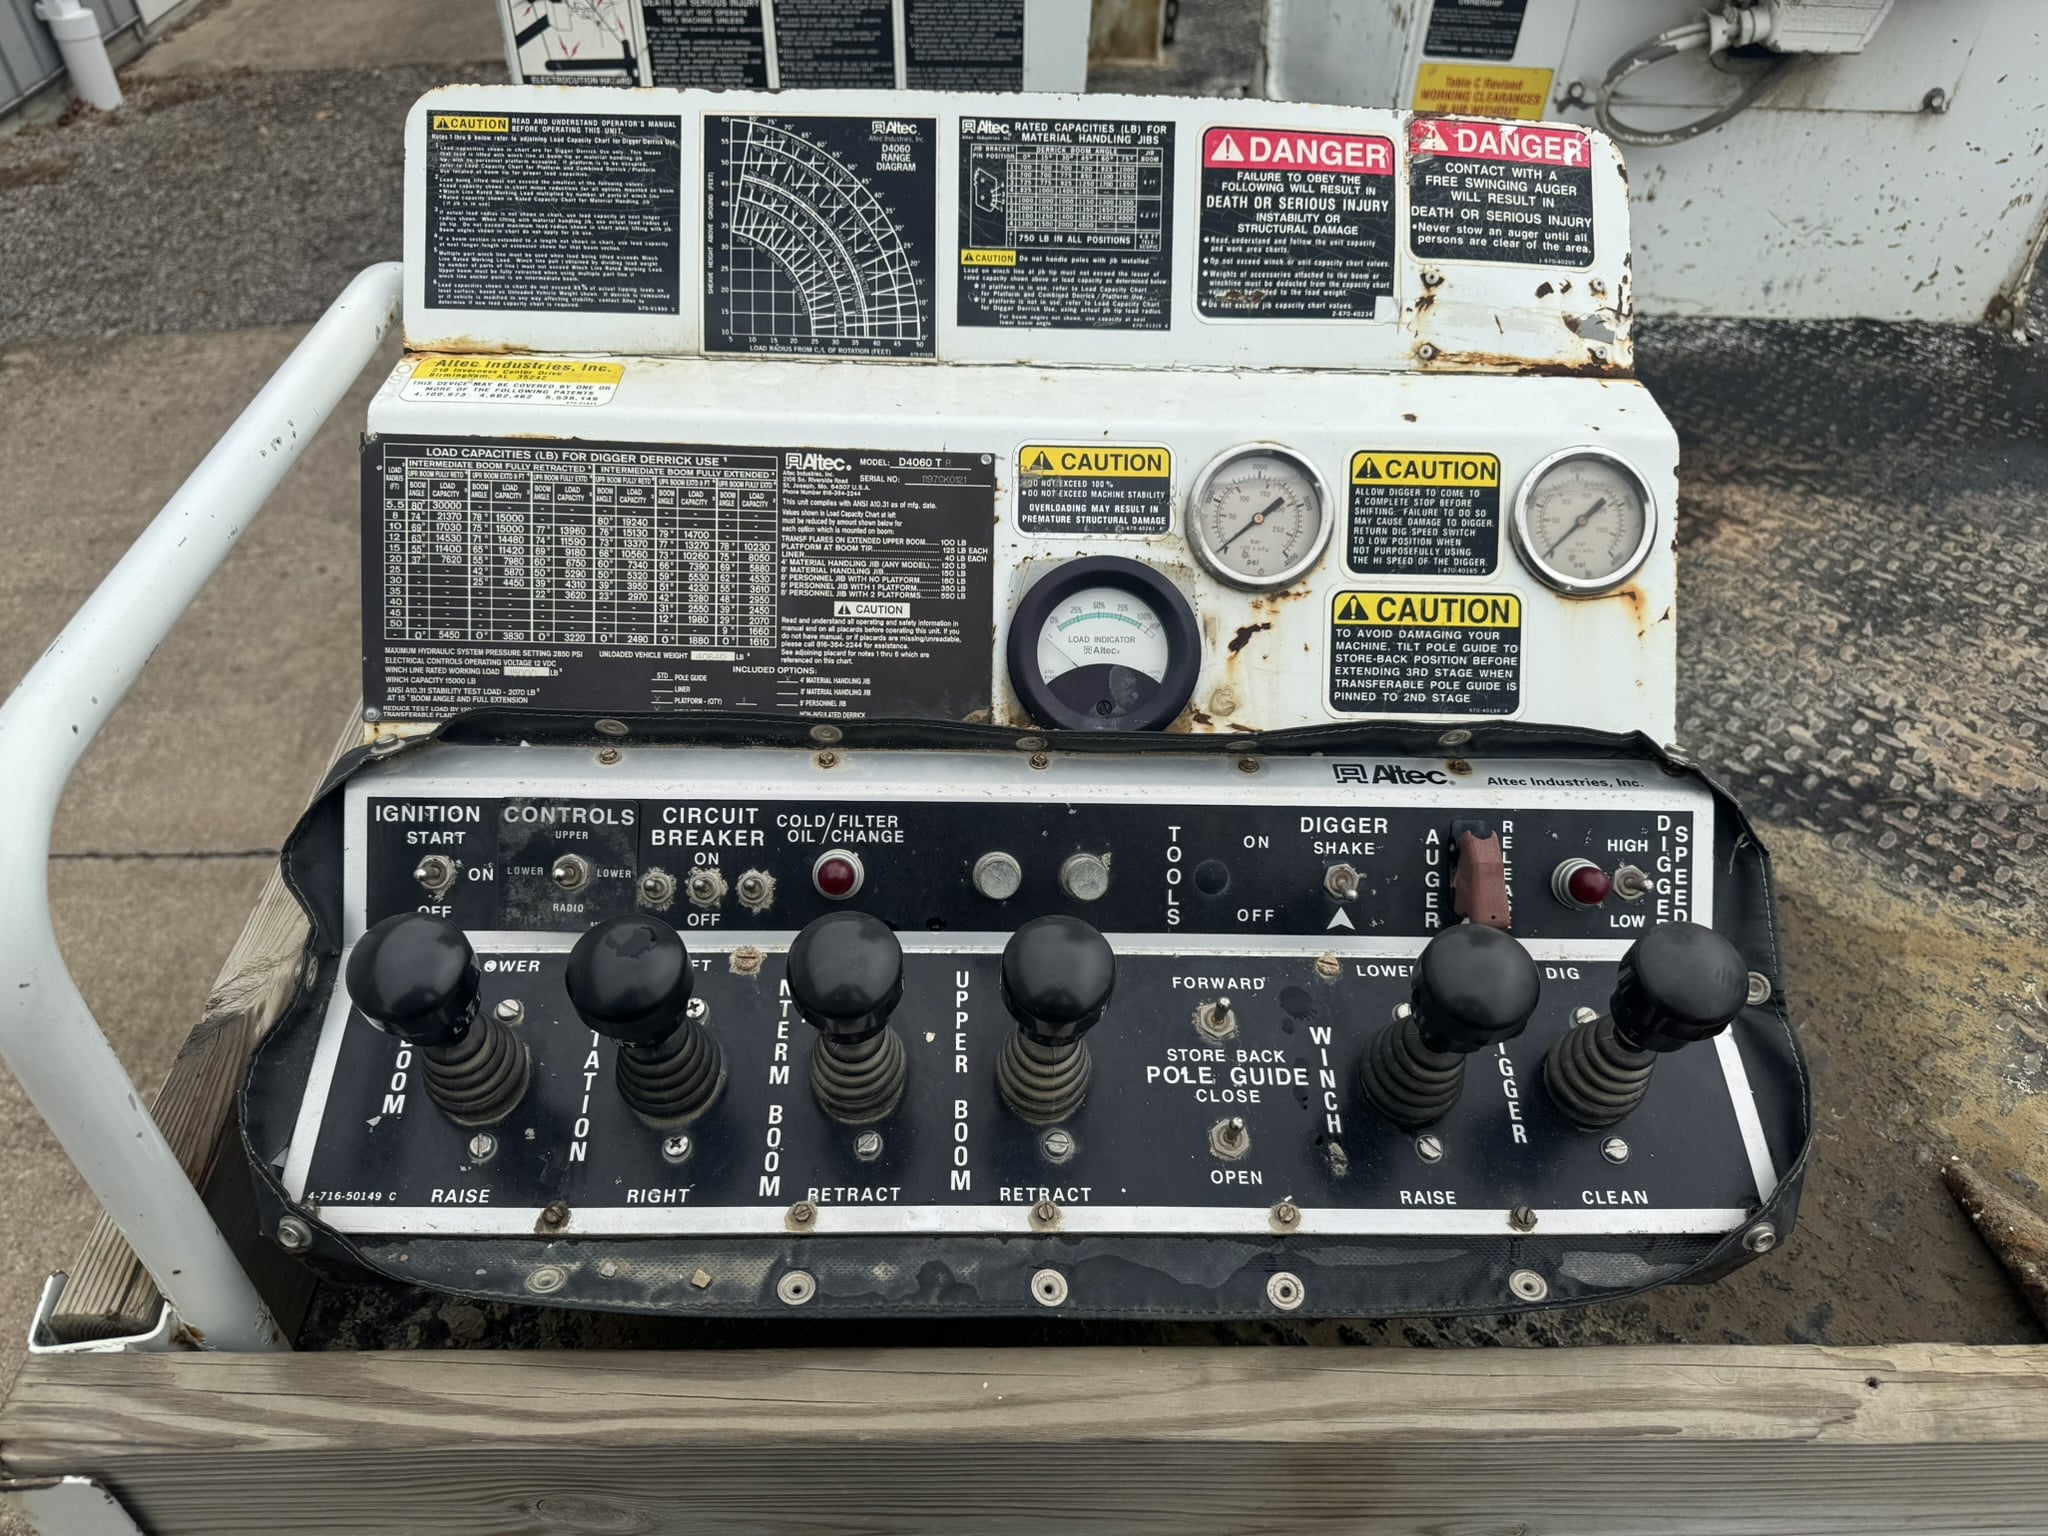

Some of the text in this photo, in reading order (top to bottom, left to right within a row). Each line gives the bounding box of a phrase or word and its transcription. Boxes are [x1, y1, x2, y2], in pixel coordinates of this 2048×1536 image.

[1420, 89, 1471, 102] WORKING
[451, 118, 506, 129] CAUTION
[885, 121, 917, 134] Altec
[977, 120, 1012, 136] Altec
[1015, 122, 1167, 135] RATED CAPACITIES (LB) FOR
[1022, 132, 1159, 145] MATERIAL HANDLING JIBS
[1458, 129, 1583, 162] DANGER
[882, 143, 911, 153] D4060
[1250, 137, 1388, 168] DANGER
[881, 153, 911, 162] RANGE
[876, 160, 916, 171] DIAGRAM
[1445, 162, 1557, 181] CONTACT WITH A
[1237, 171, 1361, 185] FAILURE TO OBEY THE
[1425, 175, 1577, 196] FREE SWINGING AUGER
[1206, 195, 1389, 212] DEATH OR SERIOUS INJURY
[1256, 212, 1340, 224] INSTABILITY OR
[1238, 223, 1358, 235] STRUCTURAL DAMAGE
[1019, 234, 1131, 245] 750 LB IN ALL POSITIONS
[434, 359, 611, 372] Altec Industries, Inc.
[426, 448, 720, 466] LOAD CAPACITIES (LB) FOR DIGGER DERRICK USE
[800, 453, 942, 471] Altec MODEL: D4060 T
[1061, 453, 1161, 471] CAUTION
[1385, 459, 1496, 480] CAUTION
[1355, 487, 1480, 498] ALLOW DIGGER TO COME TO
[1029, 503, 1158, 513] OVERLOADING MAY RESULT IN
[1022, 514, 1166, 525] PREMATURE STRUCTURAL DAMAGE
[856, 604, 903, 614] CAUTION
[1377, 597, 1509, 624] CAUTION
[1068, 635, 1136, 644] LOAD INDICATOR
[1336, 628, 1500, 640] TO AVOID DAMAGING YOUR
[1093, 646, 1116, 655] Altec
[732, 666, 817, 675] INCLUDED OPTIONS:
[1334, 691, 1471, 703] PINNED TO 2ND STAGE
[1372, 764, 1448, 785] Altec
[1488, 777, 1645, 788] Altec Industries, Inc.
[376, 803, 480, 822] IGNITION
[504, 806, 634, 825] CONTROLS
[663, 807, 759, 824] CIRCUIT
[1301, 817, 1388, 834] DIGGER
[407, 831, 466, 844] START
[555, 830, 588, 840] UPPER
[652, 829, 764, 846] BREAKER
[1243, 835, 1269, 848] ON
[1314, 841, 1375, 855] SHAKE
[1608, 839, 1648, 852] HIGH
[694, 852, 719, 865] ON
[468, 868, 493, 881] ON
[507, 866, 543, 875] LOWER
[597, 869, 631, 878] LOWER
[1166, 826, 1182, 925] TOOLS
[1425, 829, 1440, 928] AUGER
[553, 903, 584, 913] RADIO
[687, 913, 721, 926] OFF
[1237, 909, 1274, 922] OFF
[1610, 914, 1645, 928] LOW
[484, 959, 541, 973] OWER
[1545, 967, 1580, 980] DIG
[1172, 977, 1266, 990] FORWARD
[1167, 1048, 1286, 1063] STORE BACK
[381, 1038, 412, 1115] OOM
[951, 971, 970, 1190] UPPER BOOM
[1147, 1066, 1309, 1087] POLE GUIDE
[1309, 1026, 1341, 1133] WINCH
[759, 978, 793, 1196] NTERM BOOM
[1496, 1041, 1527, 1145] IGGER
[569, 1030, 600, 1163] TATION
[1196, 1089, 1261, 1103] CLOSE
[1211, 1170, 1262, 1184] OPEN
[308, 1191, 397, 1201] 4-716-50149 C
[431, 1189, 490, 1203] RAISE
[627, 1188, 690, 1203] RIGHT
[805, 1187, 903, 1205] RETRACT
[997, 1187, 1094, 1205] RETRACT
[1400, 1190, 1456, 1205] RAISE
[1582, 1190, 1648, 1205] CLEAN
